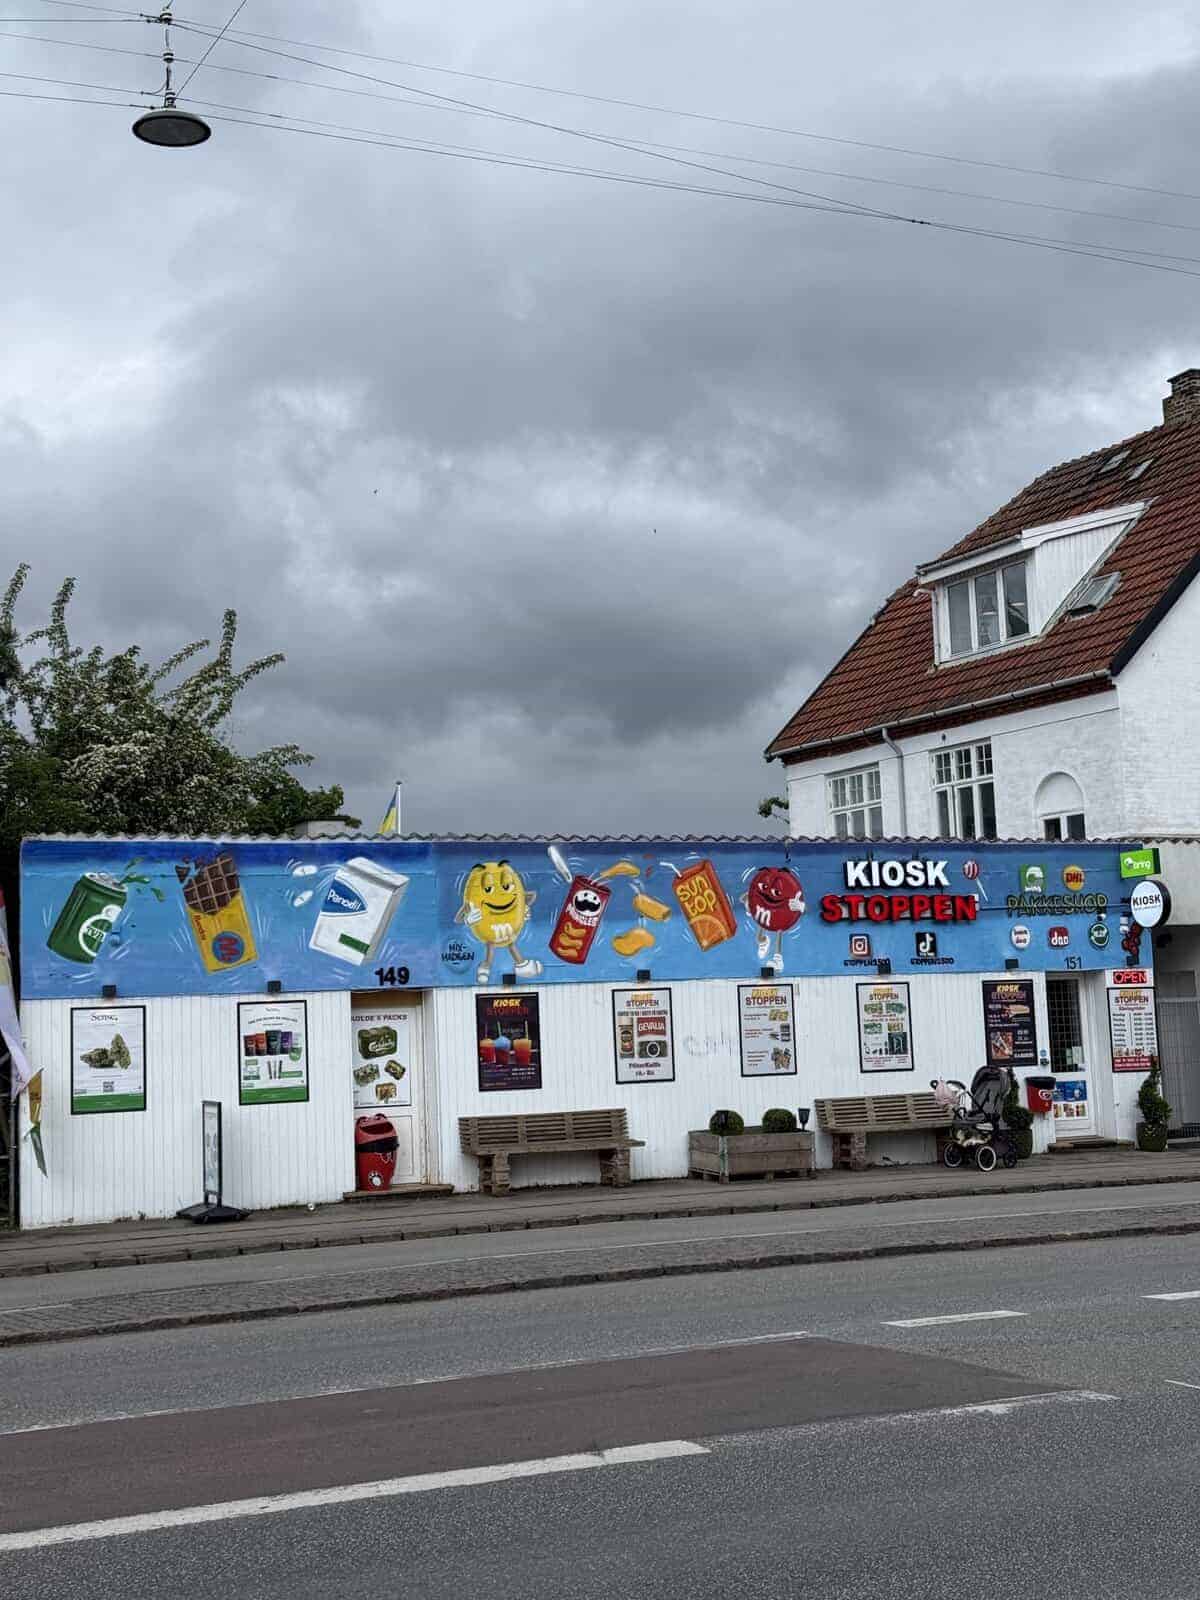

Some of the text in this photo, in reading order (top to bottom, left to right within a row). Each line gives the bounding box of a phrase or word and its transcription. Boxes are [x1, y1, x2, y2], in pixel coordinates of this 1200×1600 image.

[845, 860, 951, 887] KIOSK
[1065, 872, 1084, 883] DHL
[1132, 894, 1161, 907] KIOSK
[821, 895, 978, 922] STOPPEN
[1064, 957, 1082, 969] 151
[375, 966, 410, 986] 149
[1112, 971, 1147, 984] OPEN
[745, 995, 787, 1006] STOPPEN
